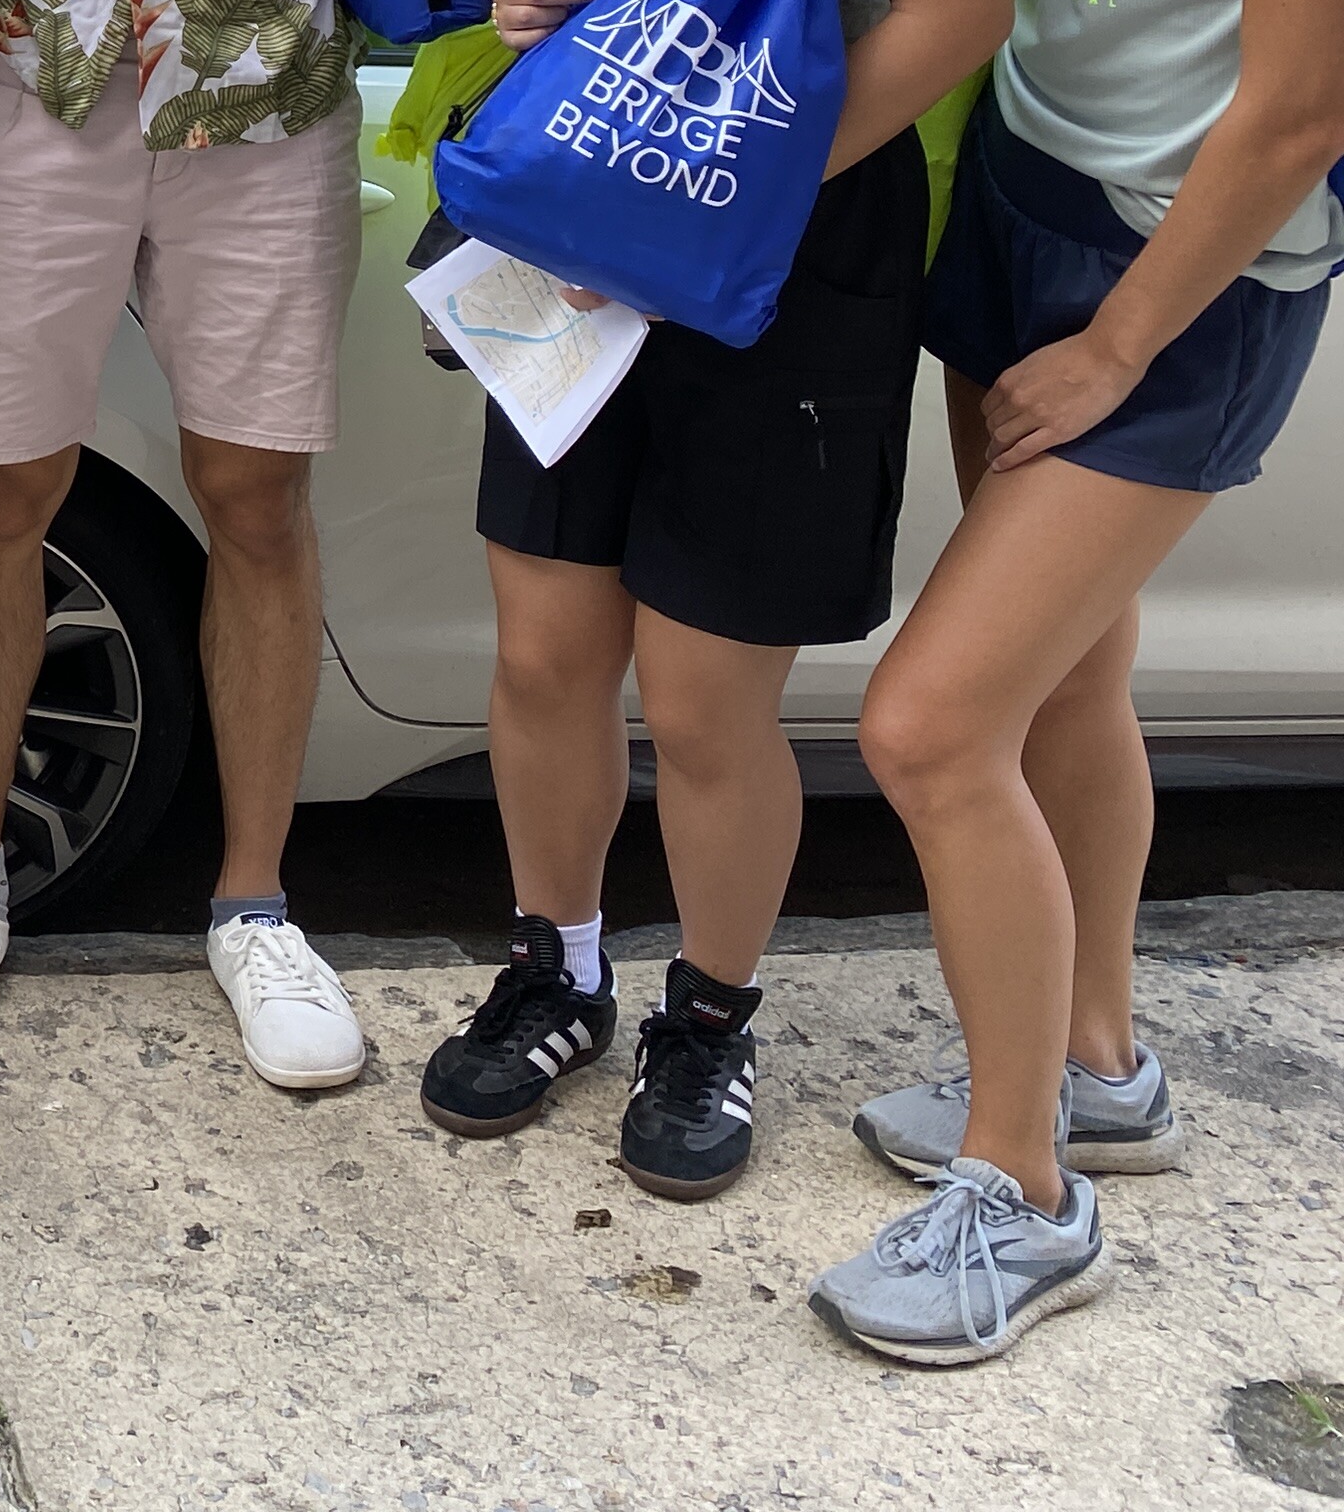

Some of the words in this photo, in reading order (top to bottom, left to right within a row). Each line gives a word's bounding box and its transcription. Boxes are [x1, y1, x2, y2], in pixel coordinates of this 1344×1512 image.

[544, 100, 739, 207] BEYOND
[582, 62, 747, 159] BRIDGE
[692, 998, 733, 1020] adidas
